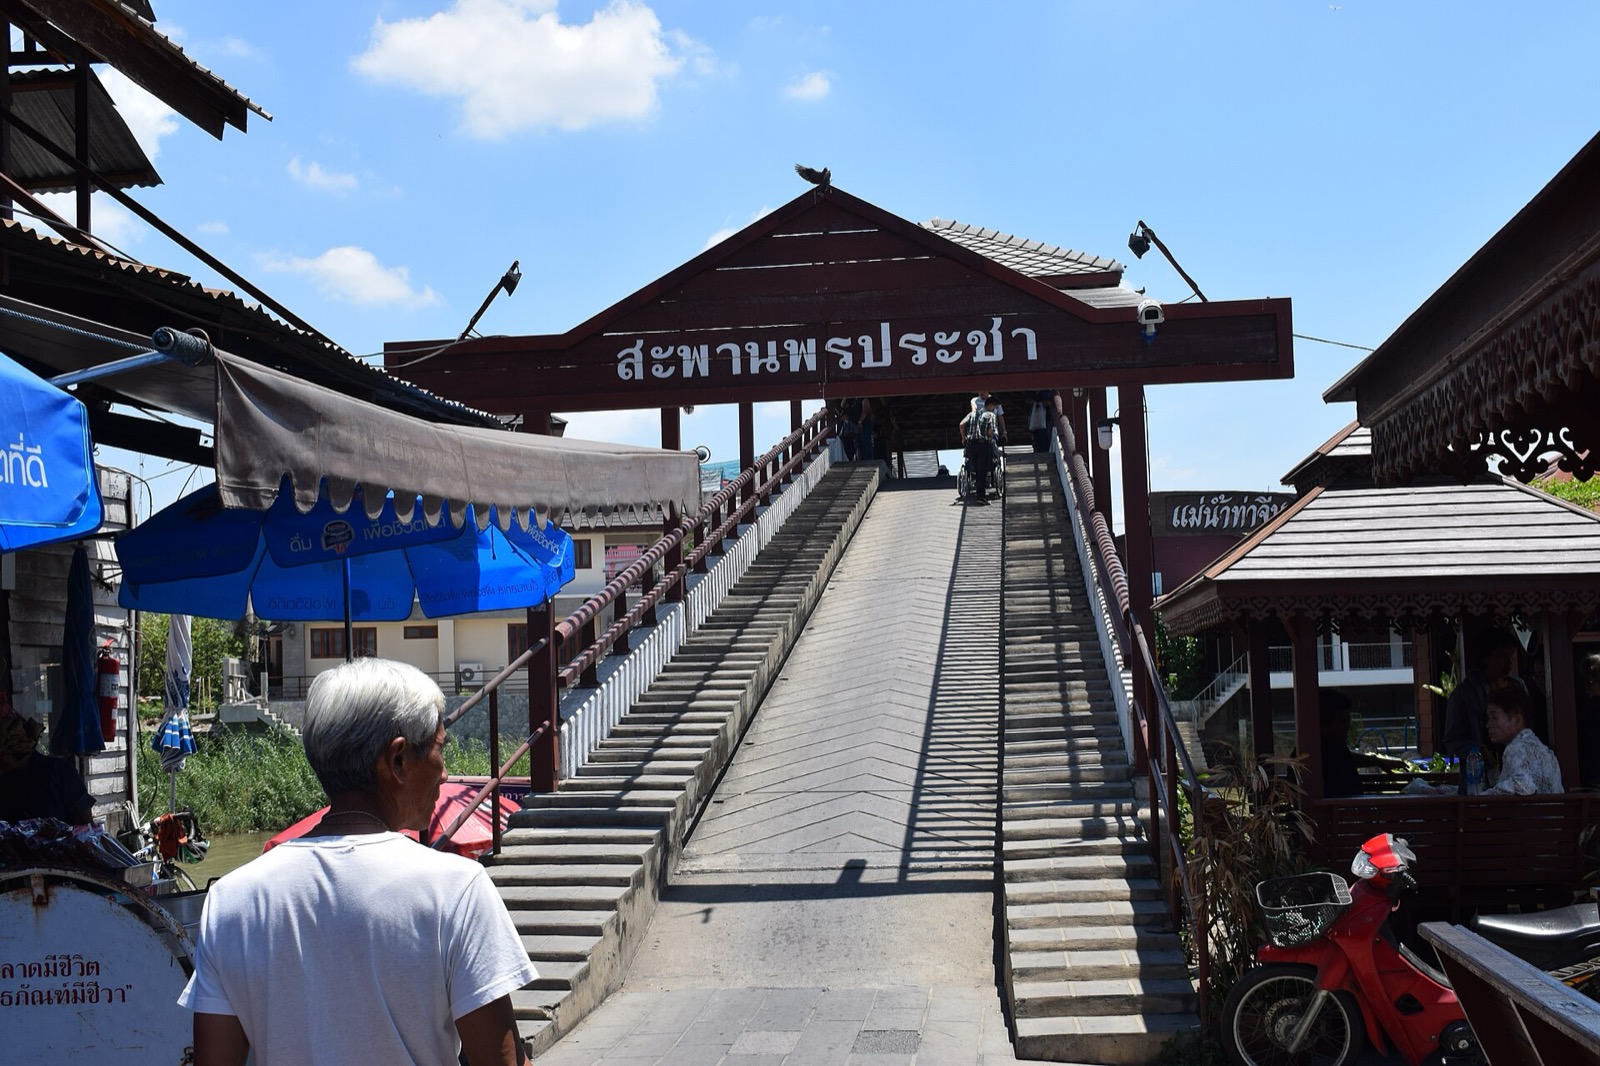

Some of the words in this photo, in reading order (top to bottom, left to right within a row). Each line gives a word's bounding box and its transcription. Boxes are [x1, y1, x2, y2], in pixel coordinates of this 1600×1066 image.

[616, 317, 1038, 380] สะพานพรประชา
